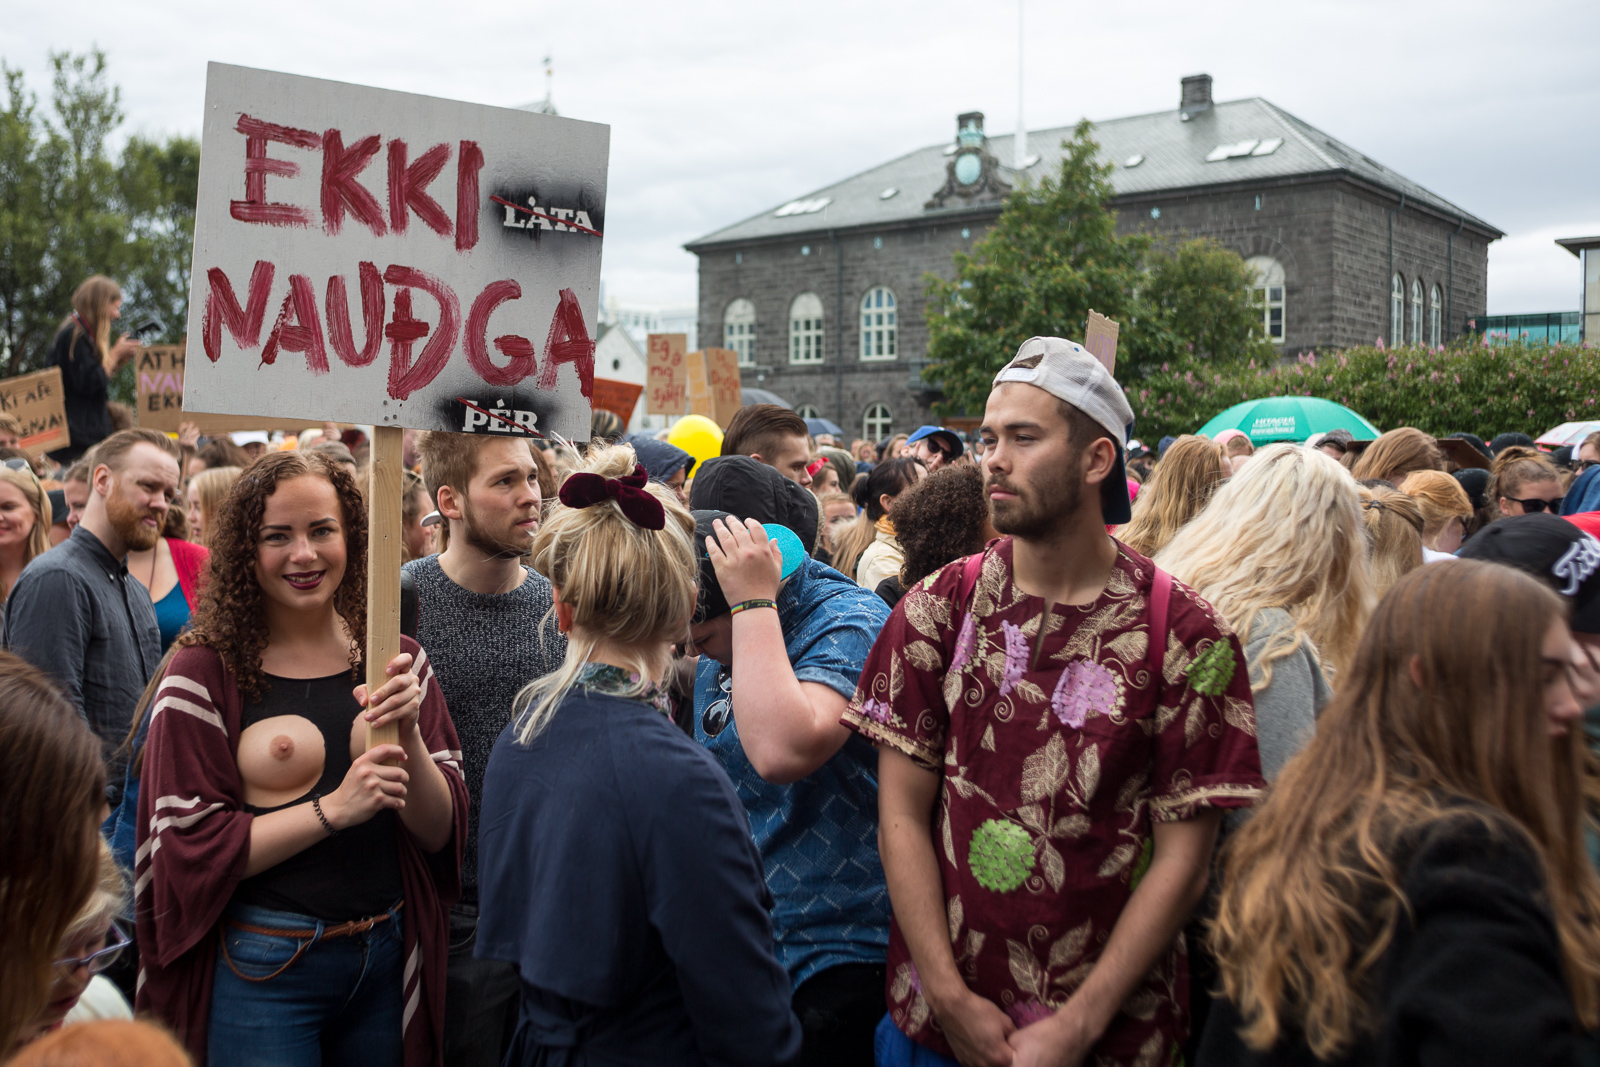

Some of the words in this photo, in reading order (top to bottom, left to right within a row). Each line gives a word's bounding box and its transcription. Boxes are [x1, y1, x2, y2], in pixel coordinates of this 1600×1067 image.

[230, 112, 485, 254] EKKI
[503, 196, 597, 233] LÁTA
[203, 260, 597, 408] NAUÐGA
[462, 399, 540, 433] ÞÉR
